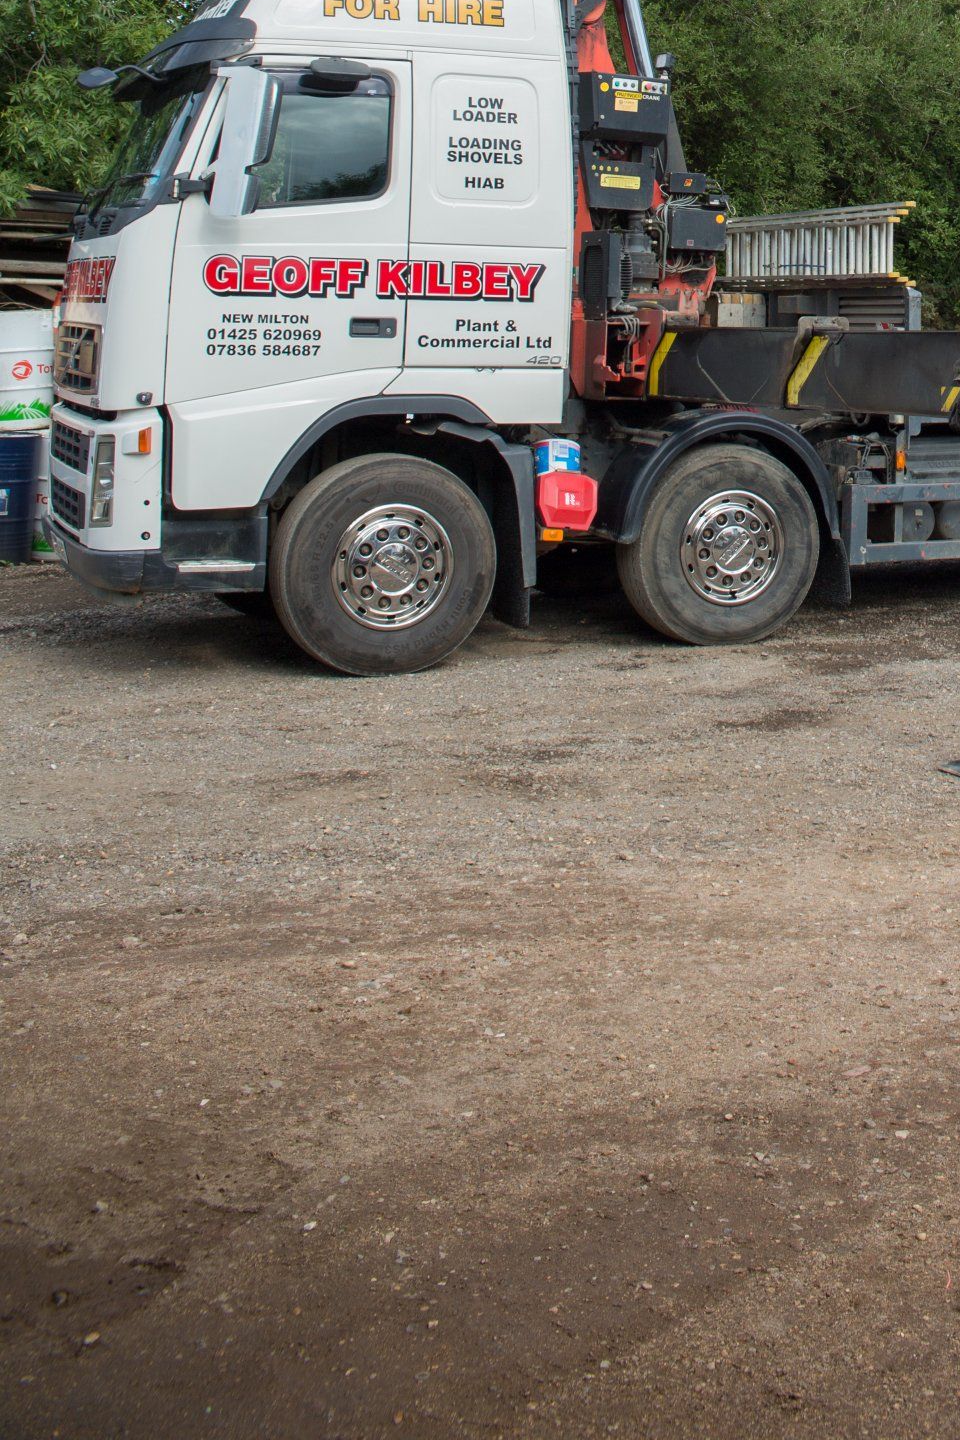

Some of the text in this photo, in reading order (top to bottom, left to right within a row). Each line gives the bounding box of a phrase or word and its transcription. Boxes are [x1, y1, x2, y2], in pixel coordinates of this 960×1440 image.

[468, 96, 503, 109] LOW
[453, 109, 518, 124] LOADER
[448, 136, 522, 151] LOADING
[447, 150, 523, 165] SHOVELS
[464, 176, 504, 189] HIAB
[203, 253, 547, 302] GEOFF KILBEY
[222, 313, 309, 324] NEW MILTON
[456, 319, 517, 332] Plant &
[207, 328, 322, 341] 01425 620969
[417, 335, 552, 349] Commercial Ltd
[206, 344, 321, 356] 07836 584687
[525, 355, 562, 365] 420
